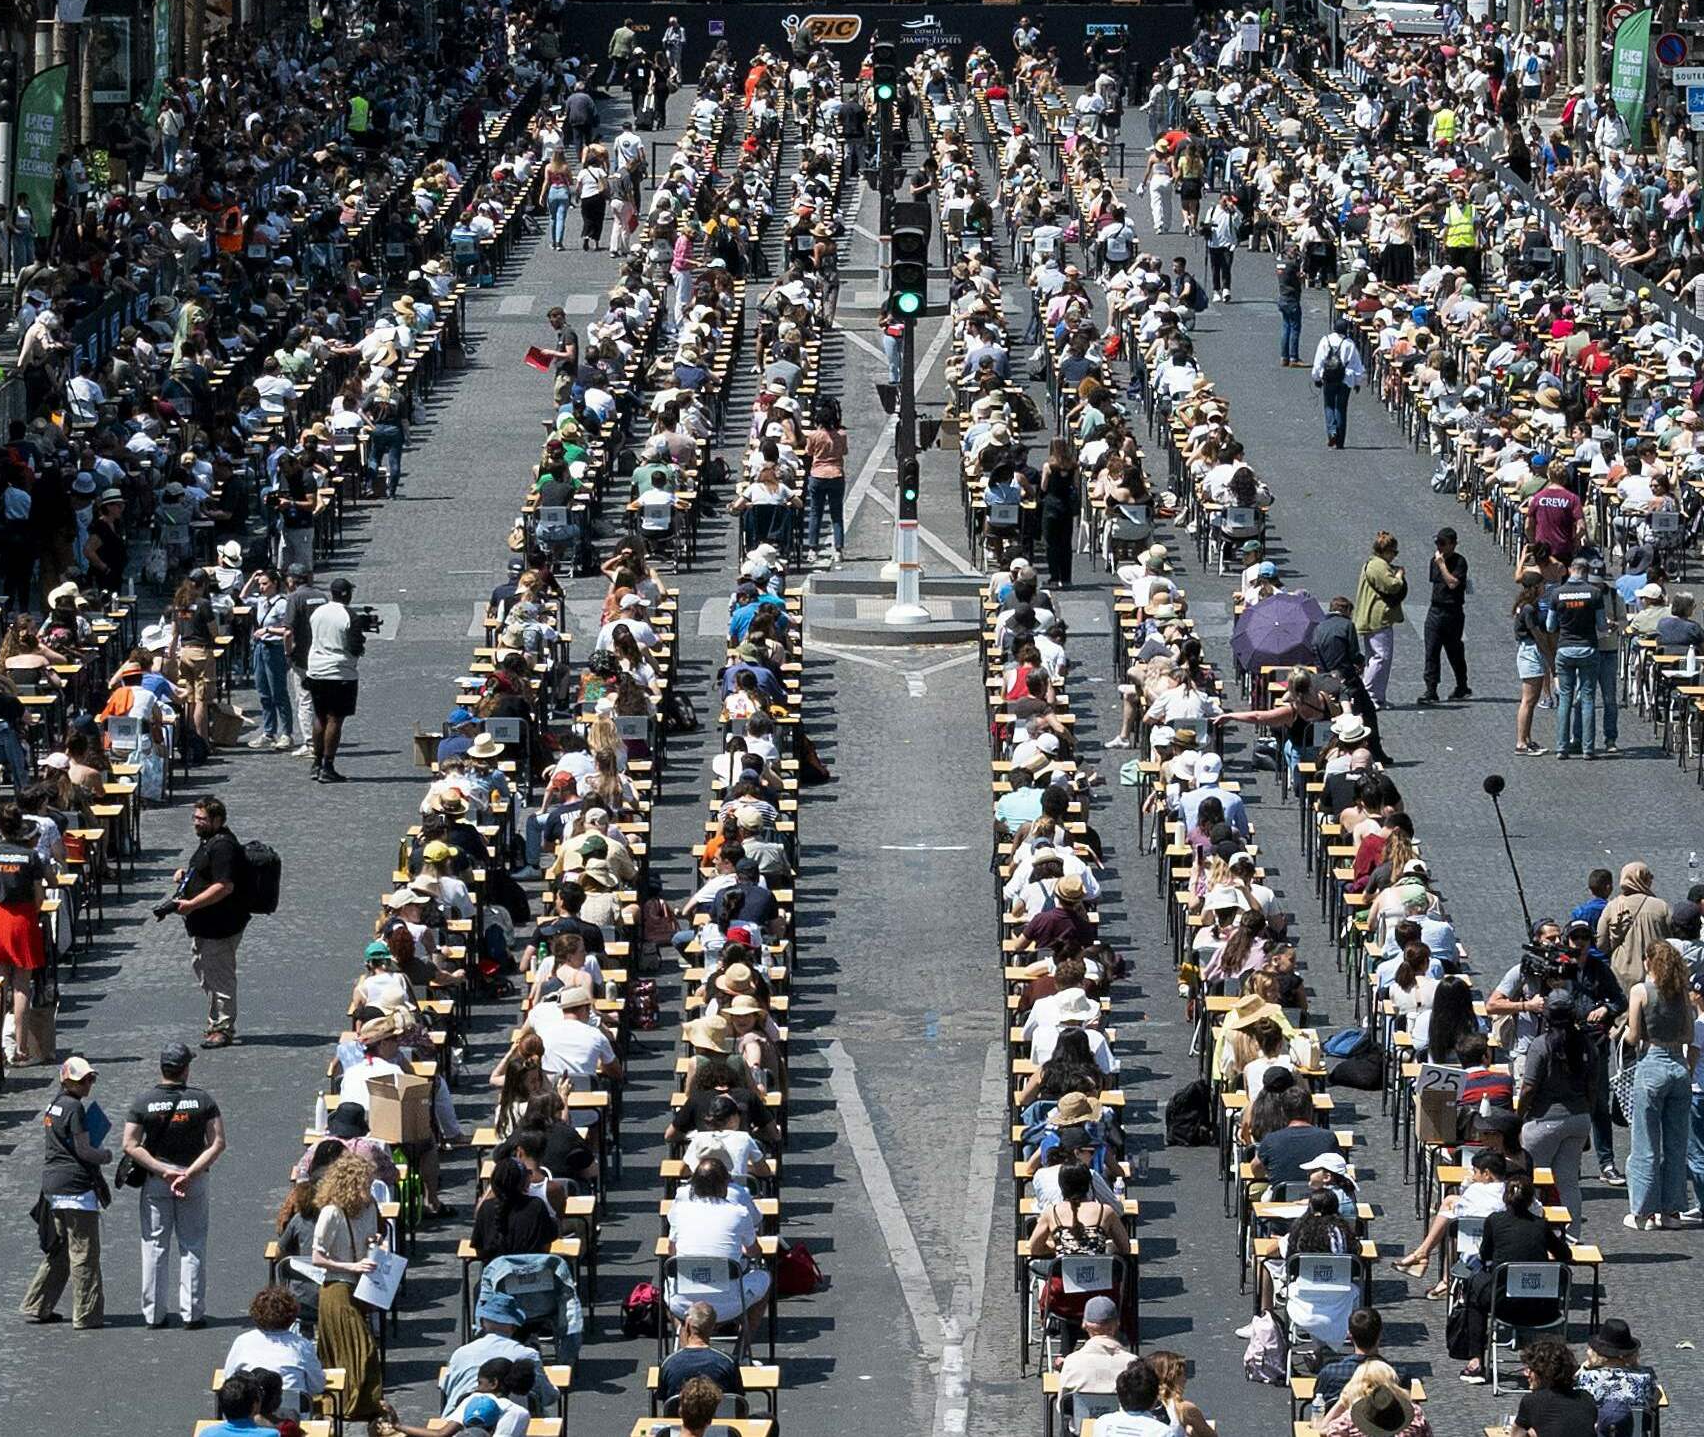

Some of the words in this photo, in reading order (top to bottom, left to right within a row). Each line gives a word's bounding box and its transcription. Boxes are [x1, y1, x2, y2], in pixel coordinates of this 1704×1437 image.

[1618, 63, 1642, 78] SORTIE
[1611, 88, 1644, 104] SECOURS
[24, 130, 52, 146] SORTIE
[30, 146, 40, 159] DE
[17, 158, 54, 174] SECOURS
[1539, 497, 1569, 507] CREW
[1422, 1070, 1462, 1091] 25
